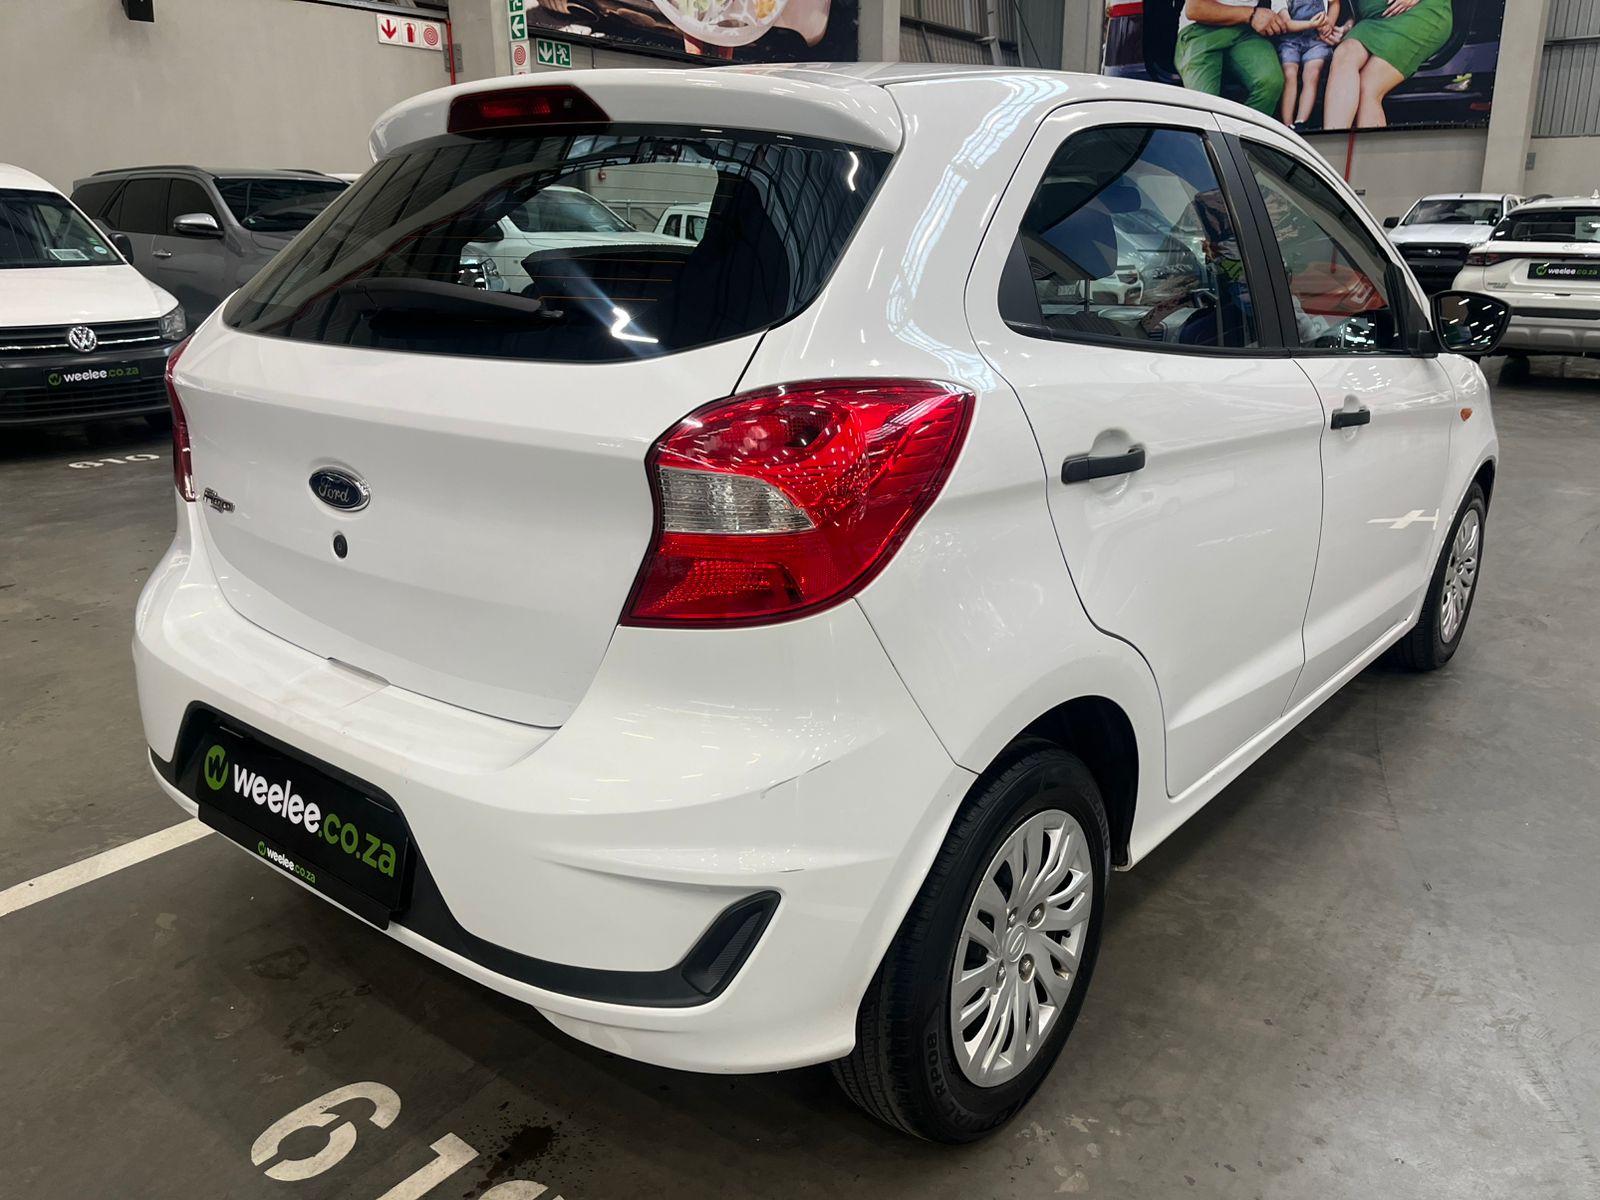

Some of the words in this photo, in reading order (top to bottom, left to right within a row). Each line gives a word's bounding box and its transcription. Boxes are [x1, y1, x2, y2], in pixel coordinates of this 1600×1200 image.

[63, 366, 139, 383] weelee.co.za
[68, 453, 160, 469] 610
[318, 475, 351, 503] Ford
[233, 763, 397, 878] weelee.co.za
[266, 847, 316, 884] weelee.co.za
[250, 1081, 565, 1200] 61
